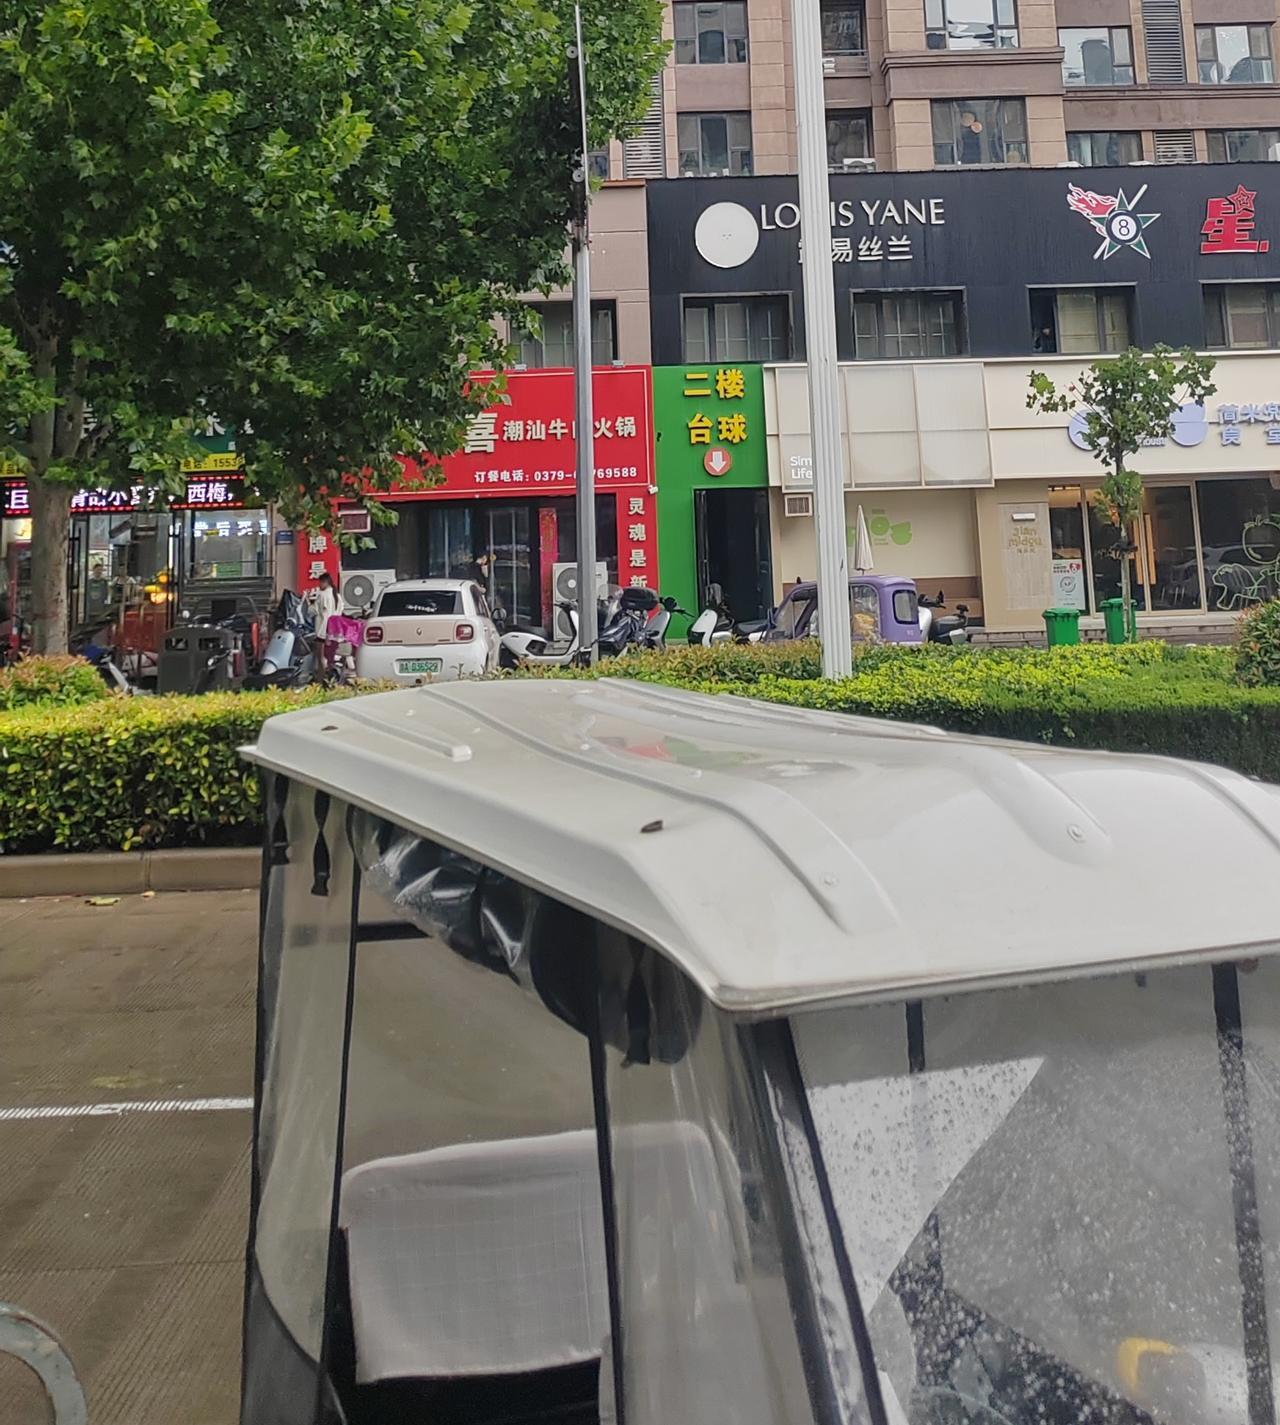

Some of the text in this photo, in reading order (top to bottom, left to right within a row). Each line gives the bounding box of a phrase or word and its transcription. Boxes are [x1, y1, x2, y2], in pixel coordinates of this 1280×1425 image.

[760, 199, 945, 230] LOIS YANE
[798, 235, 913, 263] 易丝兰
[684, 369, 745, 399] 二楼
[463, 412, 499, 453] 喜
[502, 416, 637, 442] 潮汕牛火锅
[688, 413, 747, 444] 台球
[474, 467, 637, 483] 订餐电话：0379-69588
[790, 456, 813, 467] Sim
